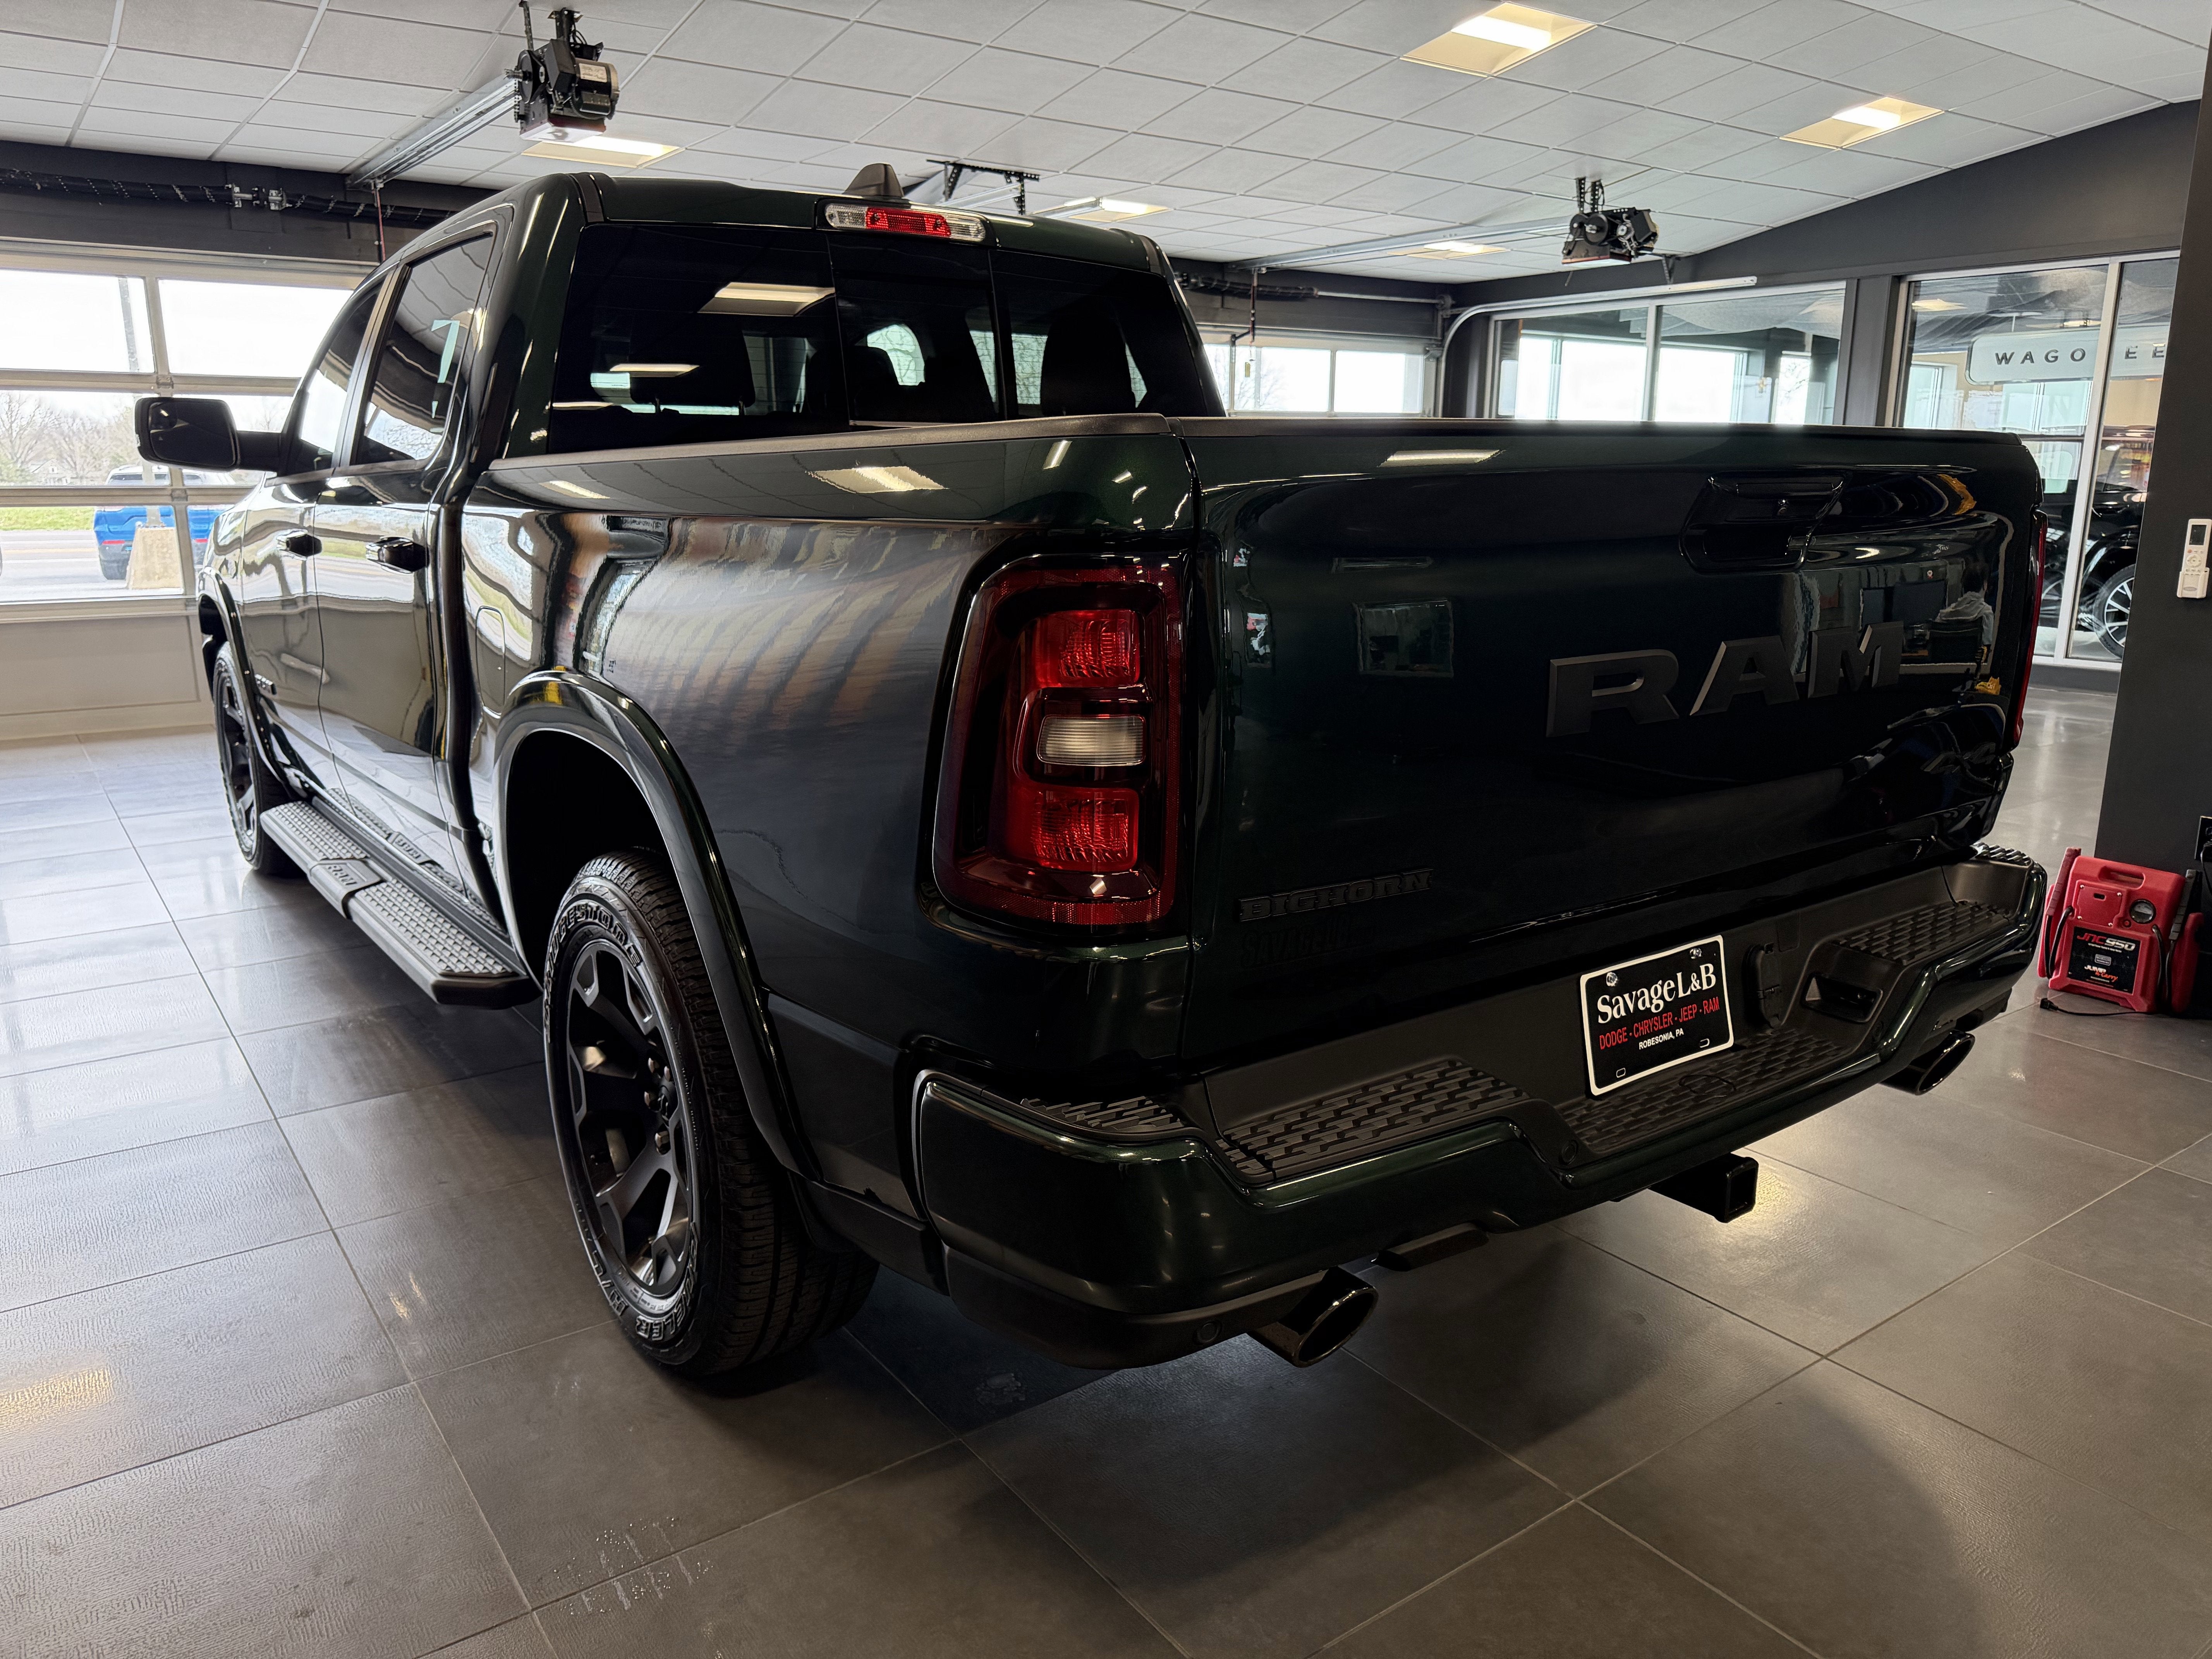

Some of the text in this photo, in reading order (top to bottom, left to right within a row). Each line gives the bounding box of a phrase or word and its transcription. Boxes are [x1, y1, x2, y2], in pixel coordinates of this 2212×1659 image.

[1995, 345, 2165, 365] WAGOEE
[1547, 621, 1903, 737] RAM
[1597, 963, 1717, 1024] Savage L&B
[1599, 996, 1720, 1050] DODGE CHRYSLER JEEP RAM
[1639, 1028, 1684, 1050] ROBESONIA, PA
